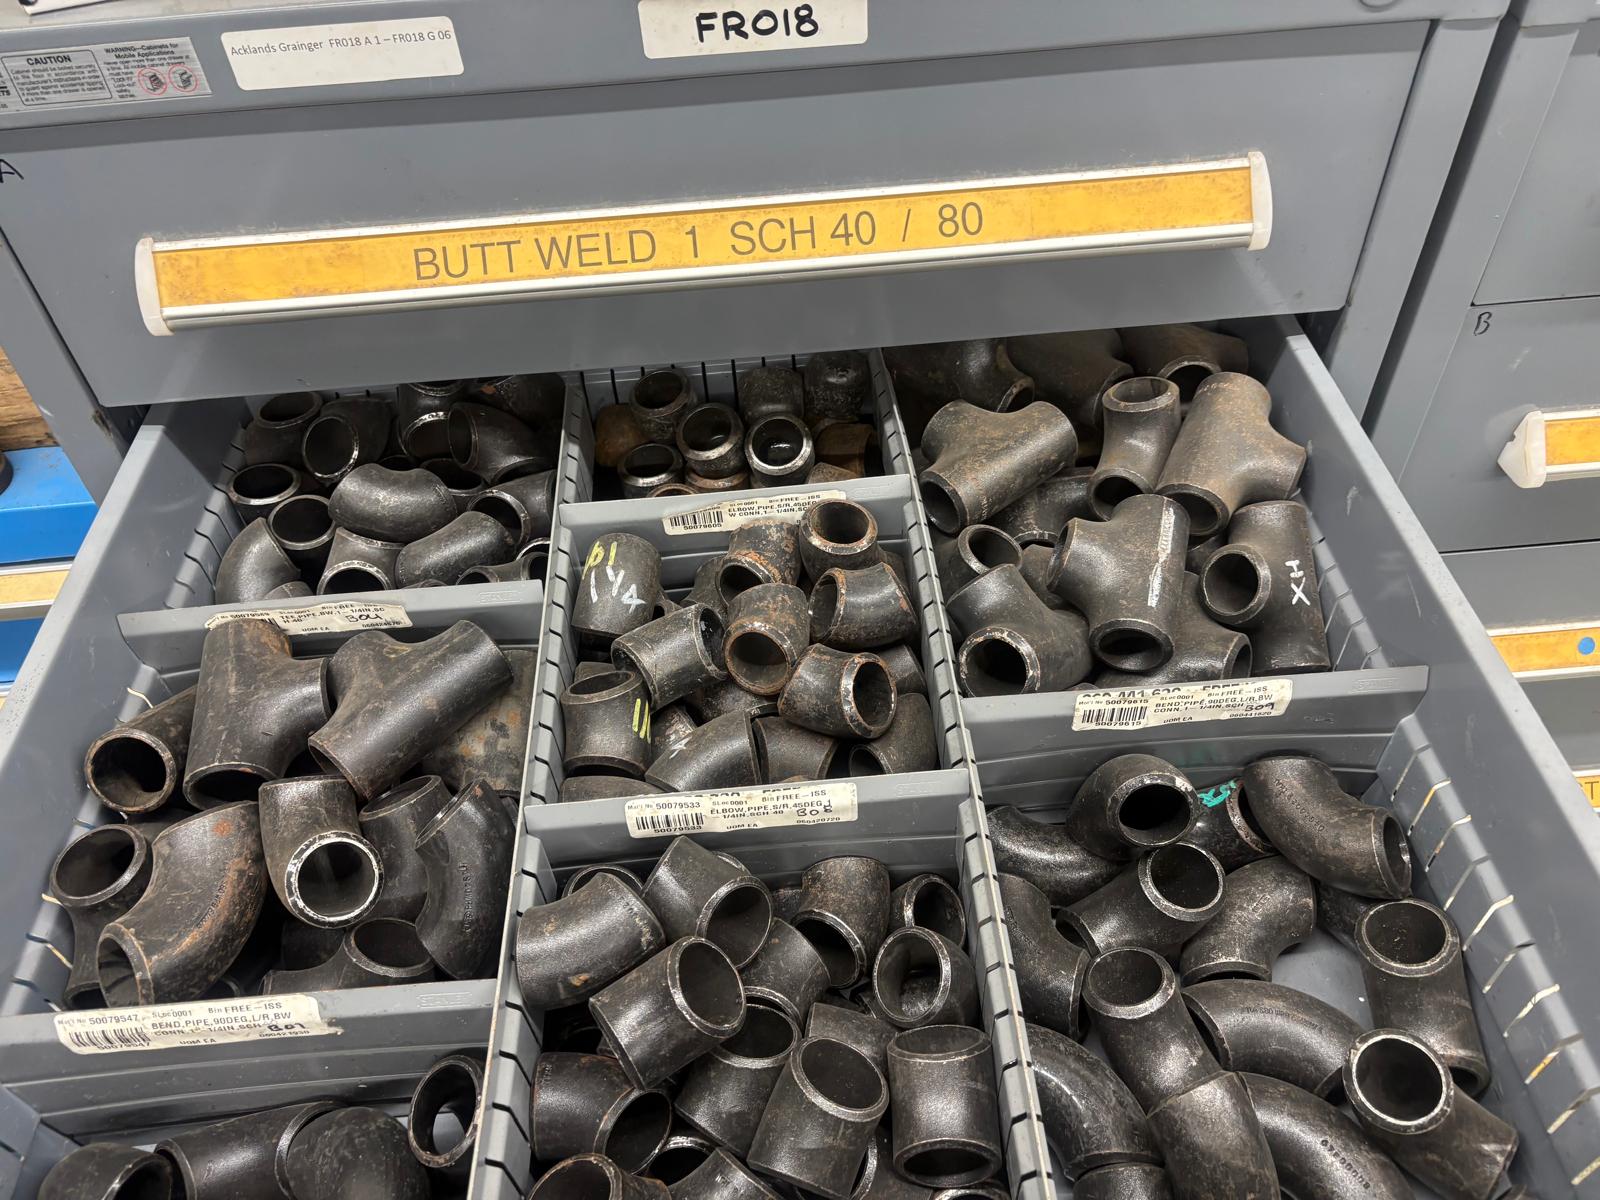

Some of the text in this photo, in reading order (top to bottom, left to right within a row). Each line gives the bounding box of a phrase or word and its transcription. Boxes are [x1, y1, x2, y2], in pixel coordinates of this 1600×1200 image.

[695, 3, 819, 43] FR018
[231, 43, 276, 57] Acklands
[278, 40, 324, 53] Grainger
[329, 36, 361, 49] FR018
[364, 36, 372, 46] A
[375, 35, 381, 45] 1
[393, 32, 425, 44] FR018
[427, 31, 435, 41] G
[437, 30, 452, 40] 06
[26, 55, 72, 66] CAUTION
[137, 50, 175, 58] Applications
[413, 201, 983, 281] BUTT WELD 1 SCH 40 / 80
[1473, 311, 1492, 337] B
[655, 802, 701, 810] 50079533
[89, 1014, 138, 1025] 50079547
